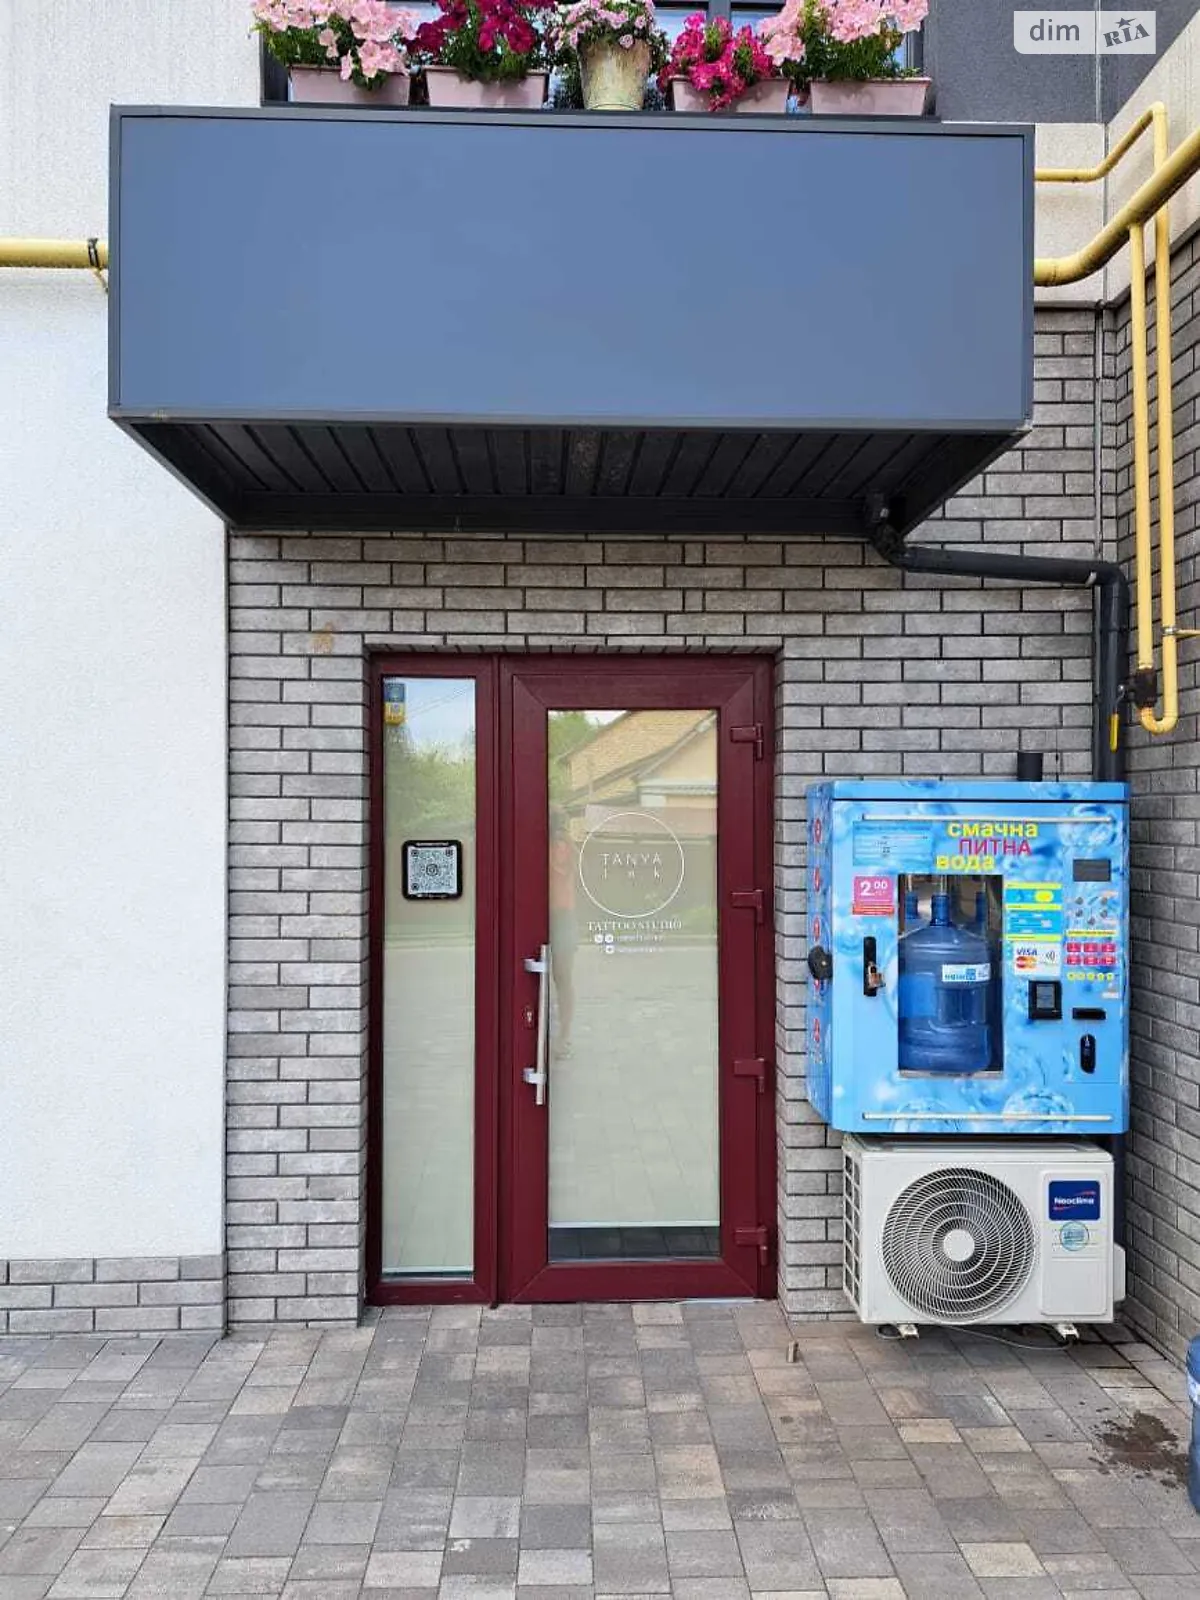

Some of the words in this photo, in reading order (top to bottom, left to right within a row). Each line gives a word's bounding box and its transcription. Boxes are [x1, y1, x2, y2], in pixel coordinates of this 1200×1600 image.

[947, 822, 1038, 837] смачна
[959, 838, 1032, 856] ПИТНА
[937, 855, 996, 872] вода
[1016, 947, 1037, 956] VISA
